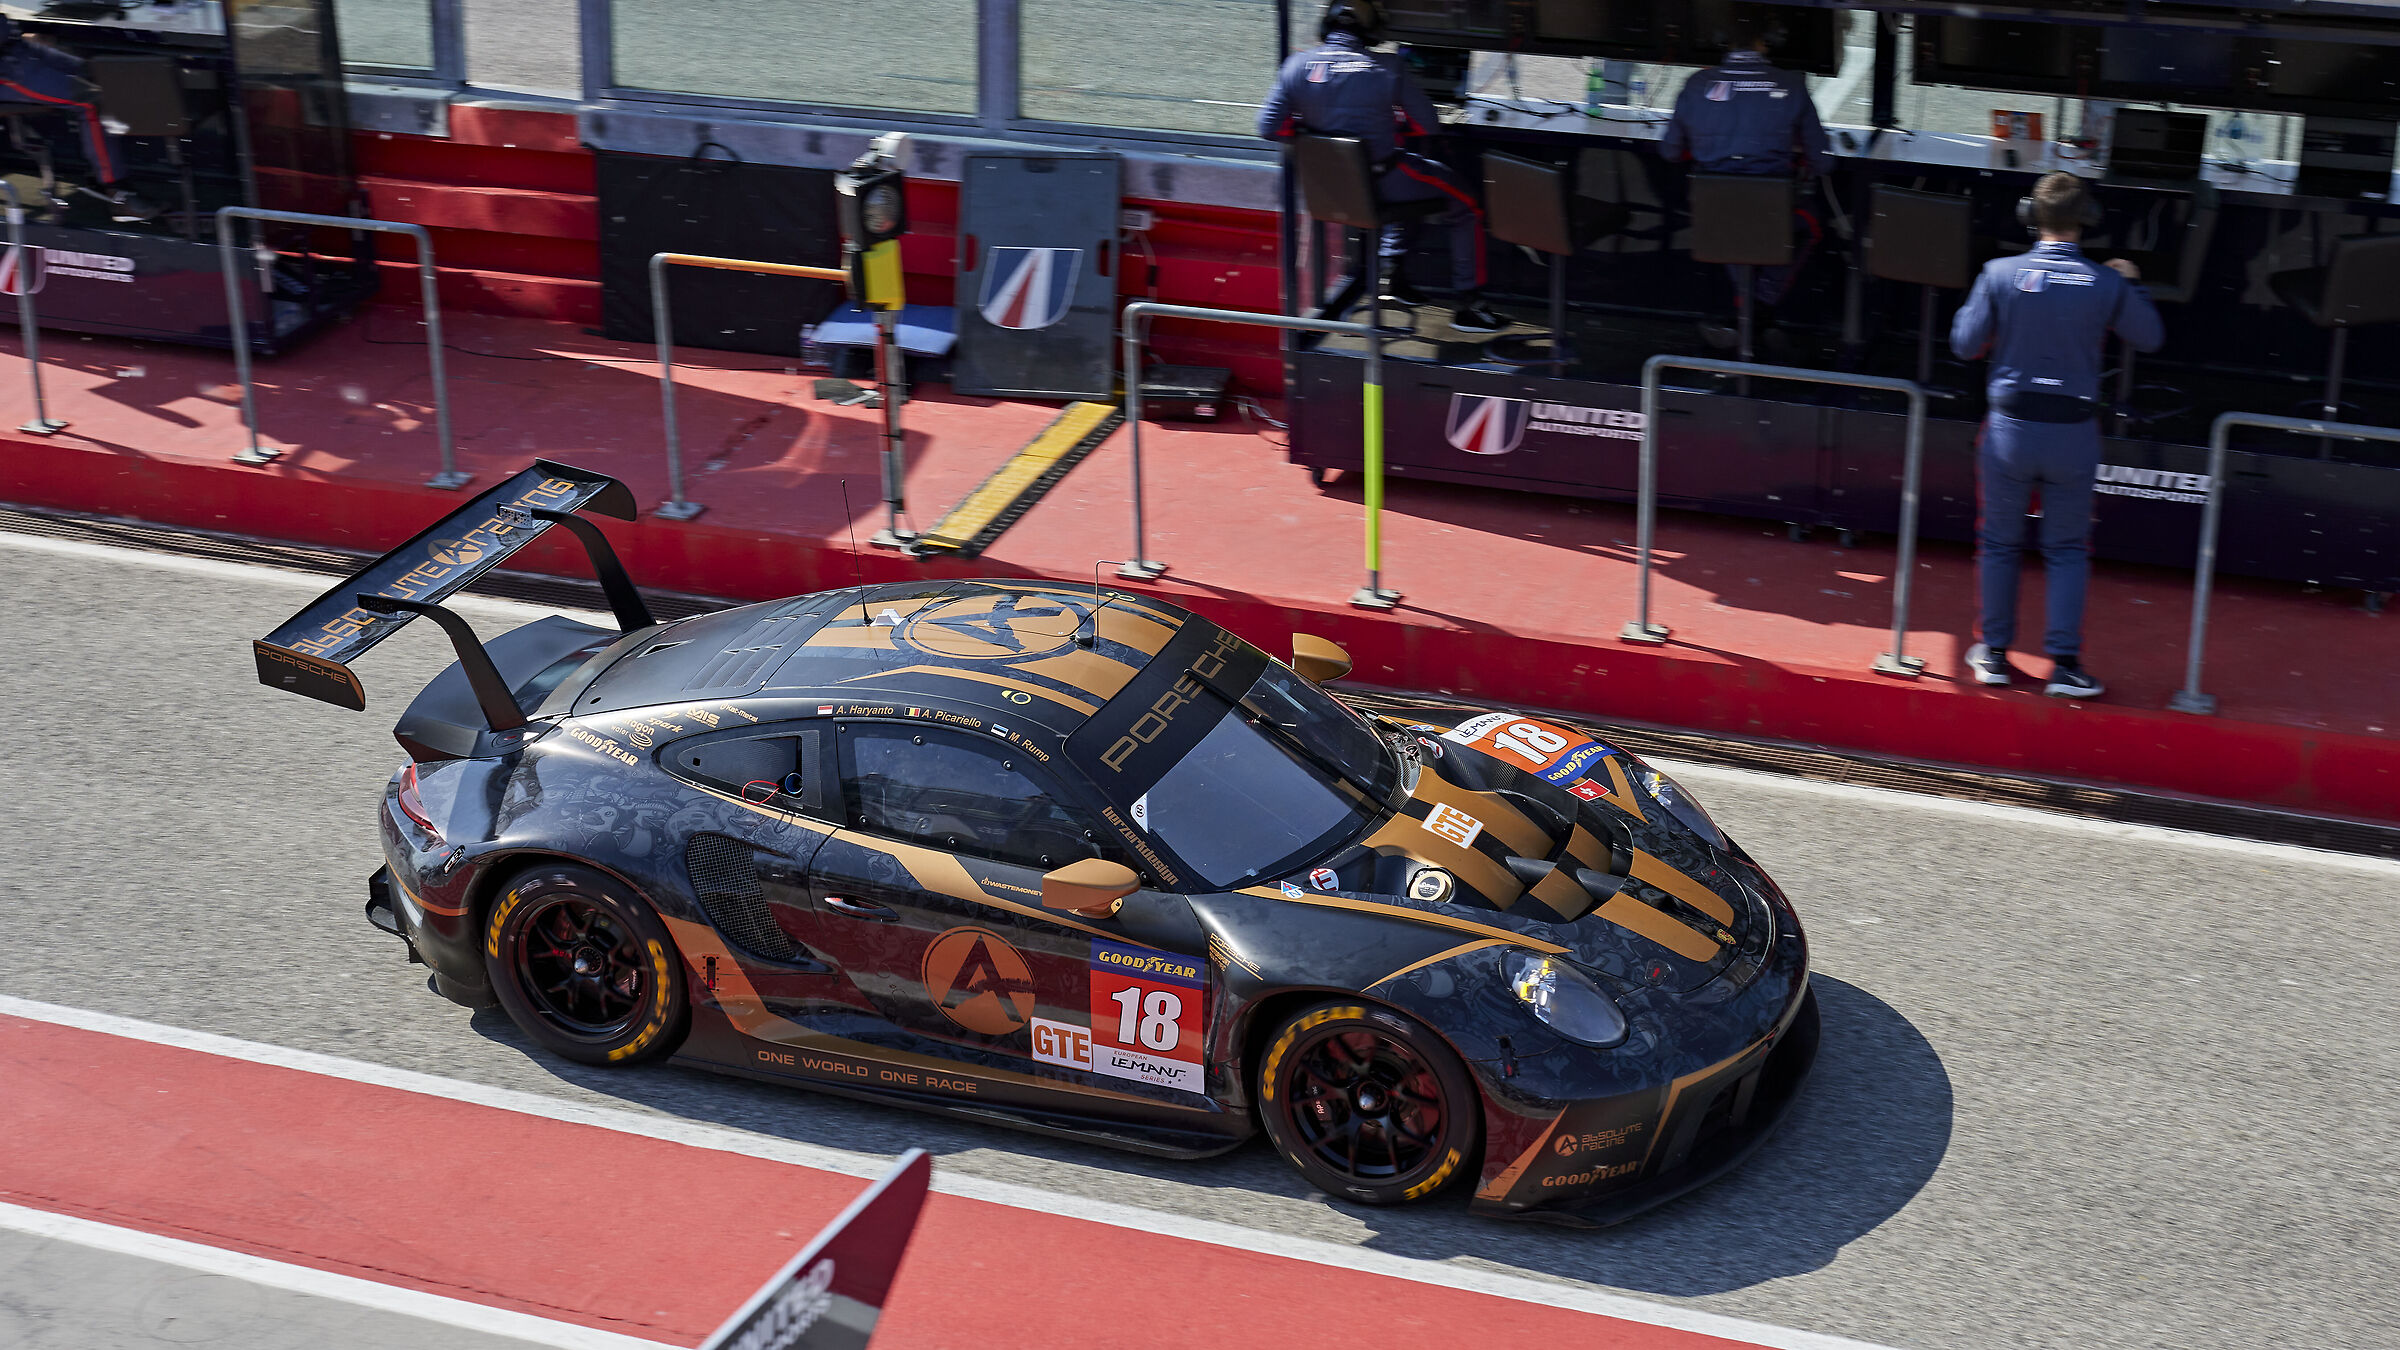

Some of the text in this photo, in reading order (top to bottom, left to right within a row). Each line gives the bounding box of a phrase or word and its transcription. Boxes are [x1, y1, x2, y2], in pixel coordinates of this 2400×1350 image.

[1531, 402, 1649, 428] UNITED
[257, 647, 348, 685] PORSCHE
[836, 705, 894, 717] A. Haryanto
[921, 709, 982, 728] A. Picariello
[1100, 630, 1242, 773] PORSCHE
[1008, 732, 1050, 763] M. Rump
[1492, 722, 1569, 766] 18
[1431, 806, 1476, 844] GTE
[488, 887, 521, 959] EAGLE
[1210, 932, 1261, 973] PORSCHE
[1111, 985, 1183, 1052] 18
[1033, 1024, 1090, 1064] GTE
[1113, 1050, 1148, 1061] EUROPEAN
[757, 1050, 977, 1094] ONE WORLD ONE RACE
[1140, 1074, 1165, 1084] SERIES
